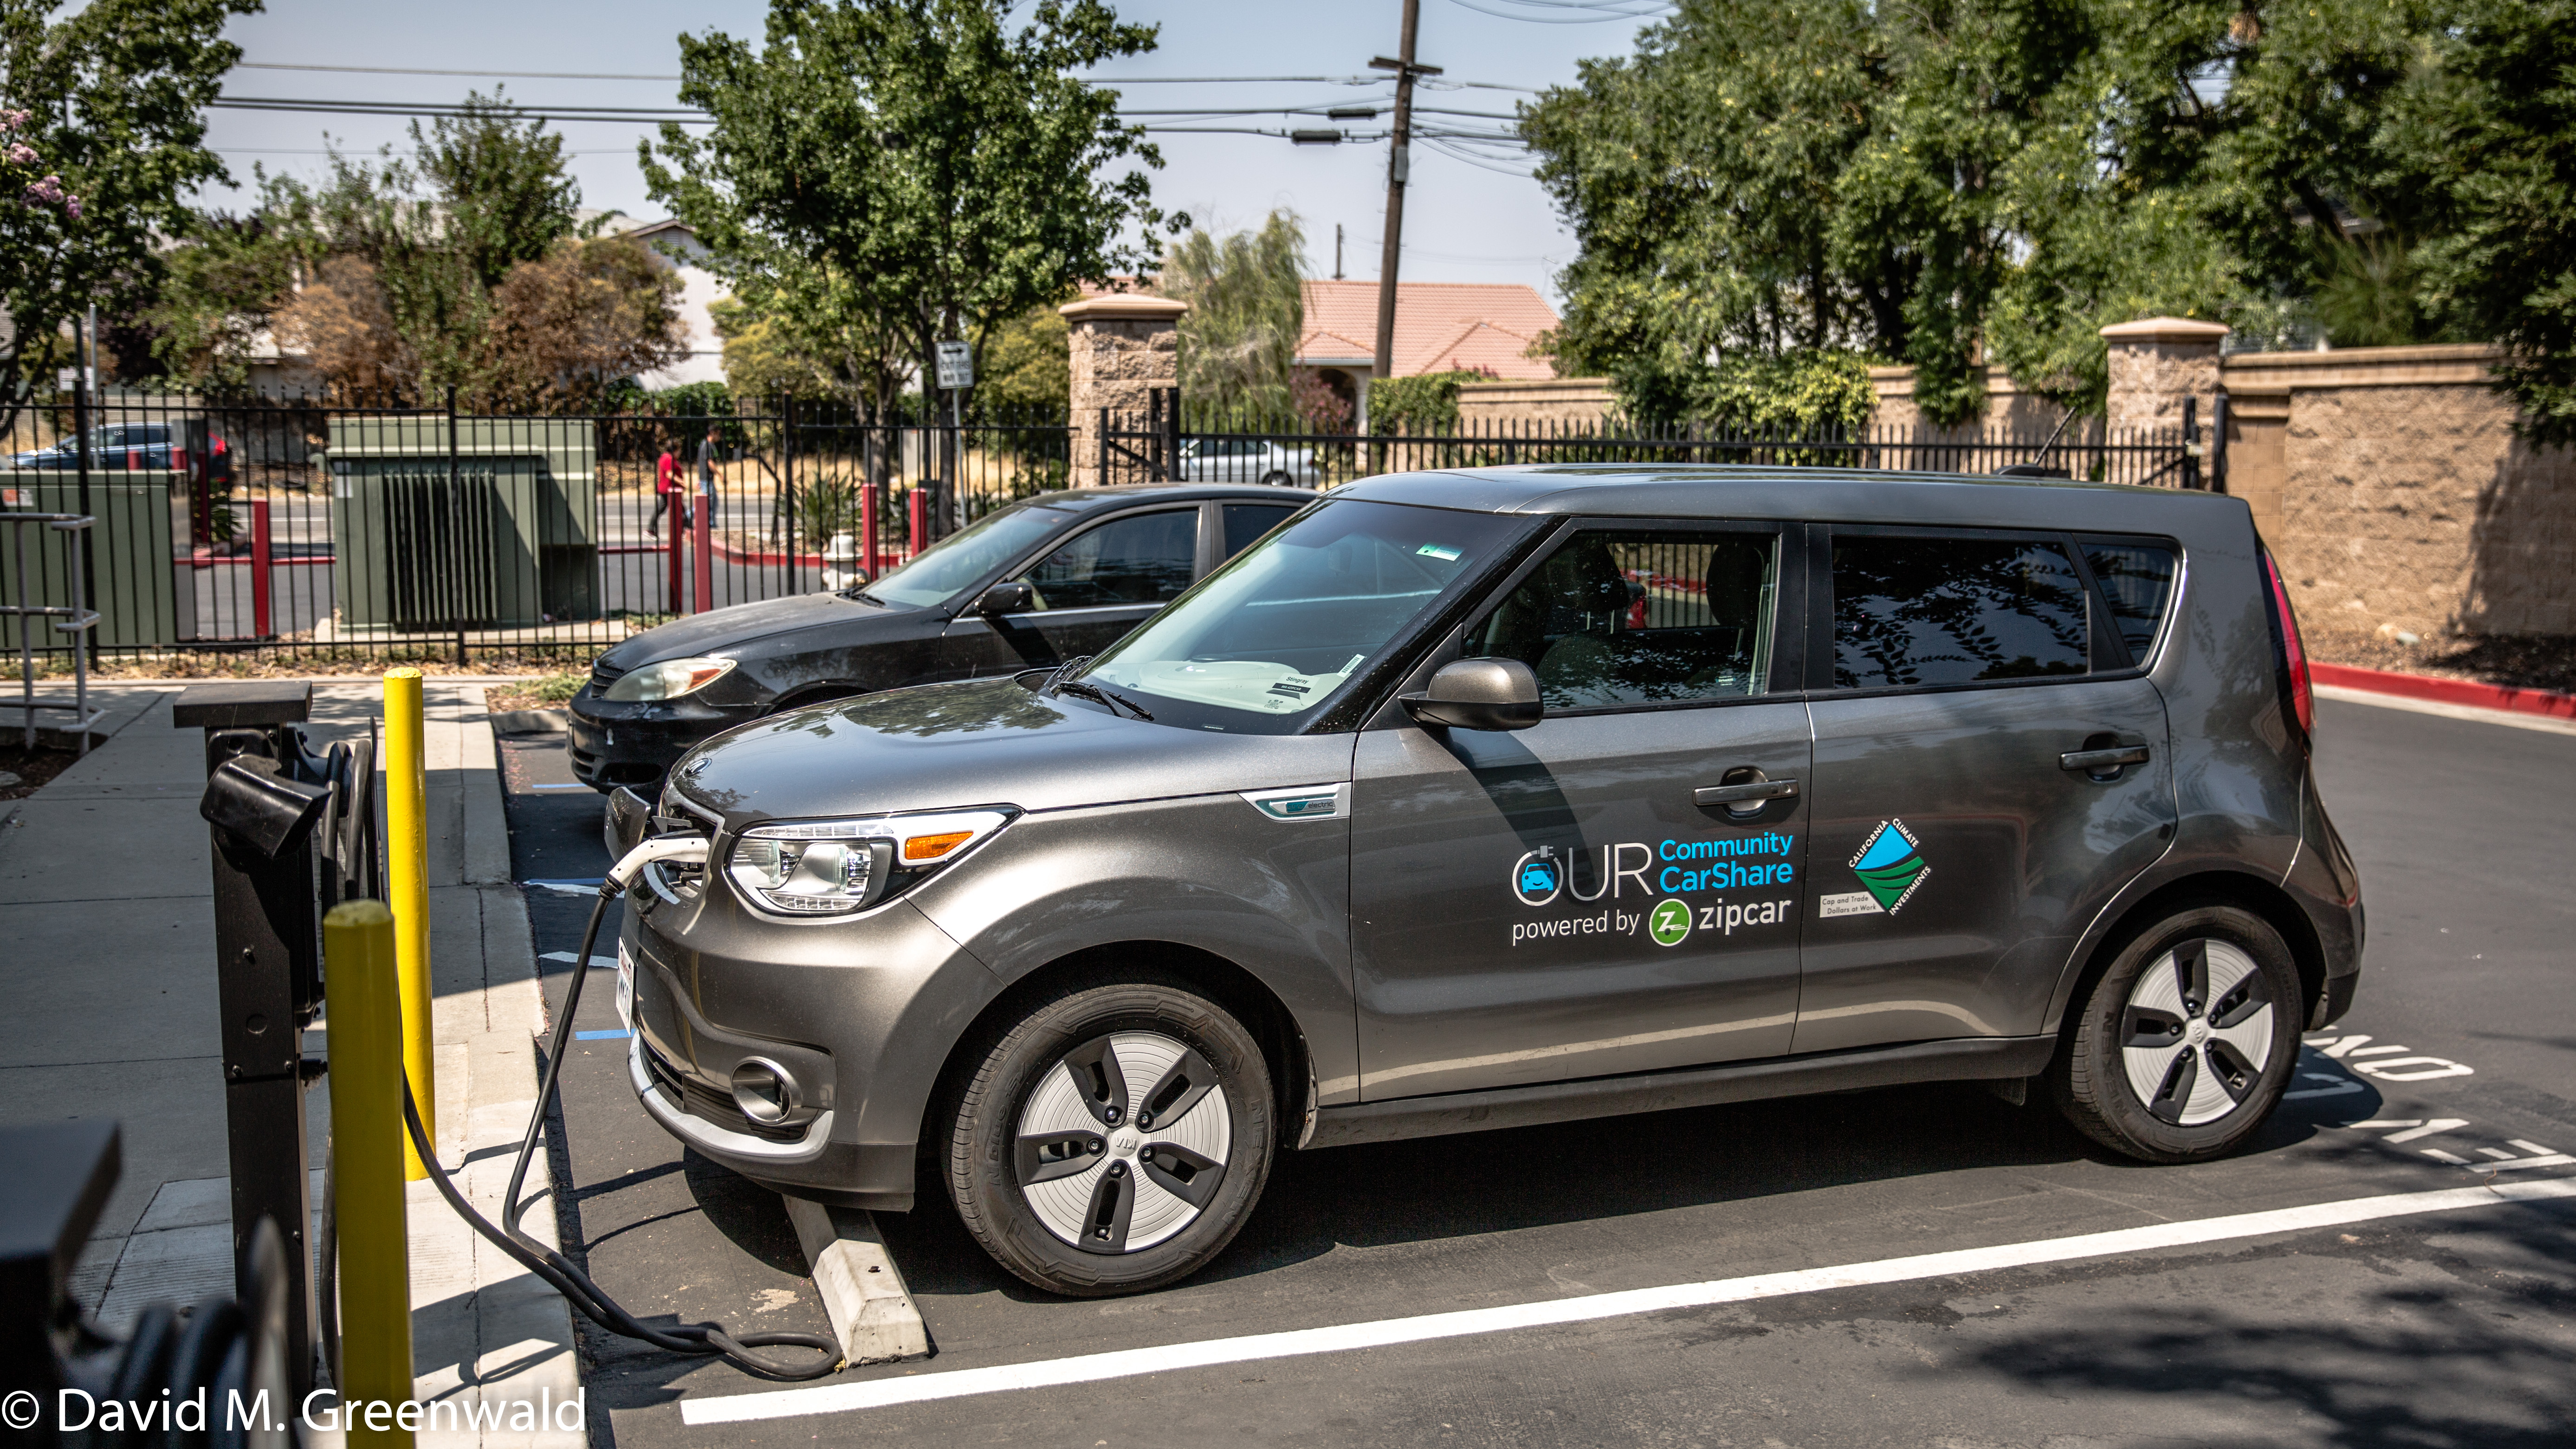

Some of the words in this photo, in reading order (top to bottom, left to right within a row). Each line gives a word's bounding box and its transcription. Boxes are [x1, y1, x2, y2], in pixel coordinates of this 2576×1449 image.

[1659, 832, 1793, 861] Community
[1848, 820, 1889, 867] CALIFORNIA
[1892, 818, 1919, 847] CLIMATE
[1512, 842, 1653, 906] OUR
[1659, 860, 1793, 893] CarShare
[1889, 866, 1931, 916] INVESTMENTS
[1513, 910, 1608, 946] powered
[1616, 909, 1640, 936] by
[1699, 898, 1792, 935] zipcar
[1115, 1136, 1137, 1150] KIA
